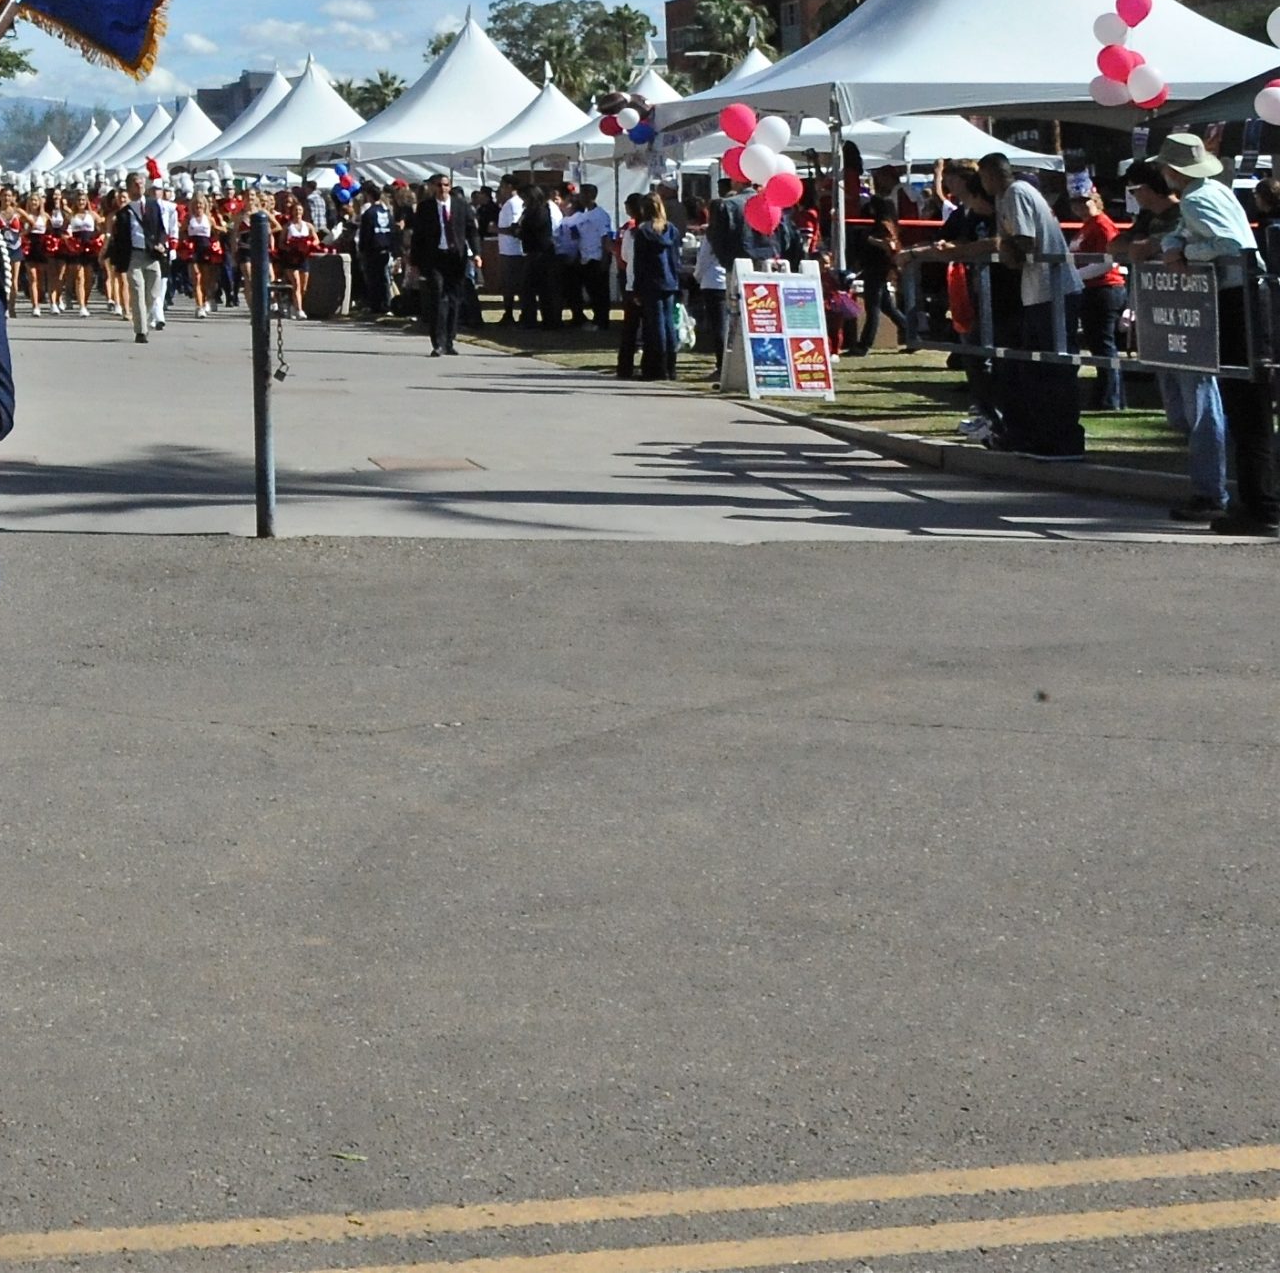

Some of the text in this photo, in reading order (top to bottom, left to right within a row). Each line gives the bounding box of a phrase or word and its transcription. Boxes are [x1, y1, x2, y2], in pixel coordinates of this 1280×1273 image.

[1140, 273, 1209, 293] NO GOLF CARTS
[747, 296, 777, 310] Sale
[1152, 307, 1201, 327] WALK YOUR
[1167, 333, 1187, 353] BIKE
[793, 351, 825, 364] Sale
